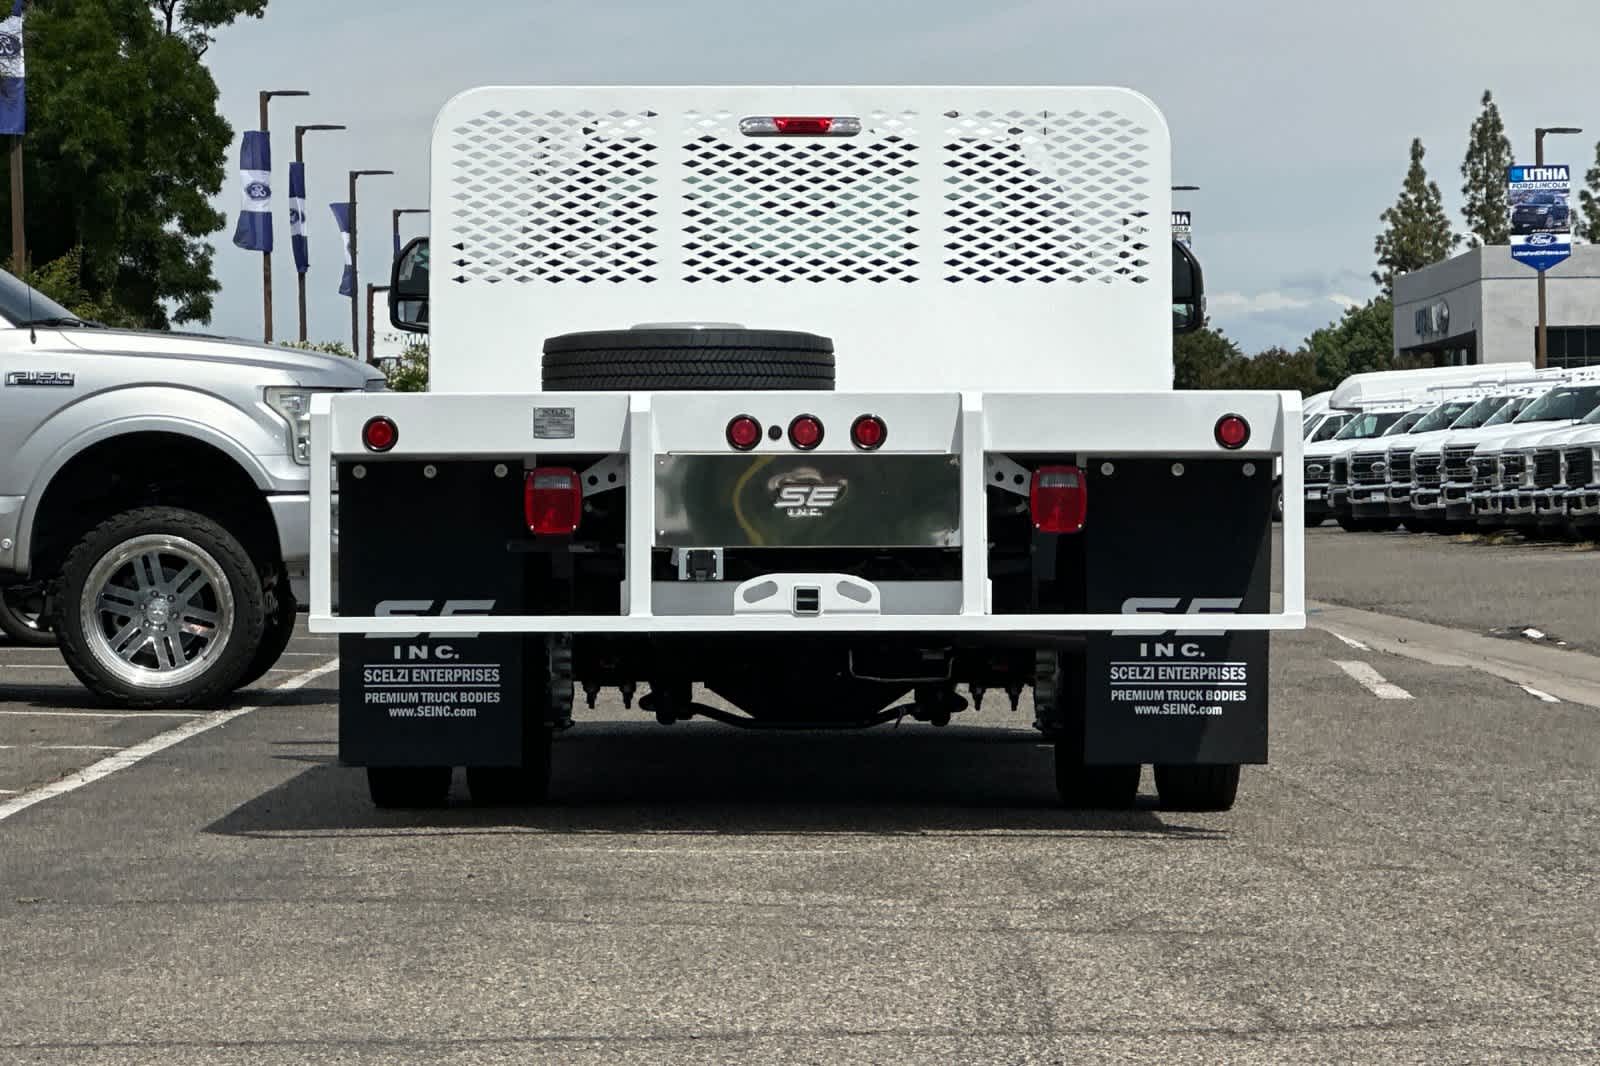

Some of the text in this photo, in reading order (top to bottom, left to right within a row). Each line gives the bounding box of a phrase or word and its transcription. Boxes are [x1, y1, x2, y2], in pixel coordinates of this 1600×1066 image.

[1523, 168, 1568, 180] LITHIA
[774, 486, 839, 507] SE
[394, 645, 460, 660] INC.
[1140, 643, 1205, 657] INC.
[364, 669, 500, 682] SCELZI ENTERPRISES
[1110, 667, 1247, 680] SCELZI ENTERPRISES
[365, 691, 501, 703] PREMIUM TRUCK BODIES
[1111, 690, 1247, 701] PREMIUM TRUCK BODIES
[389, 706, 477, 717] www.SEINC.com
[1135, 704, 1223, 715] www.SEINC.com
